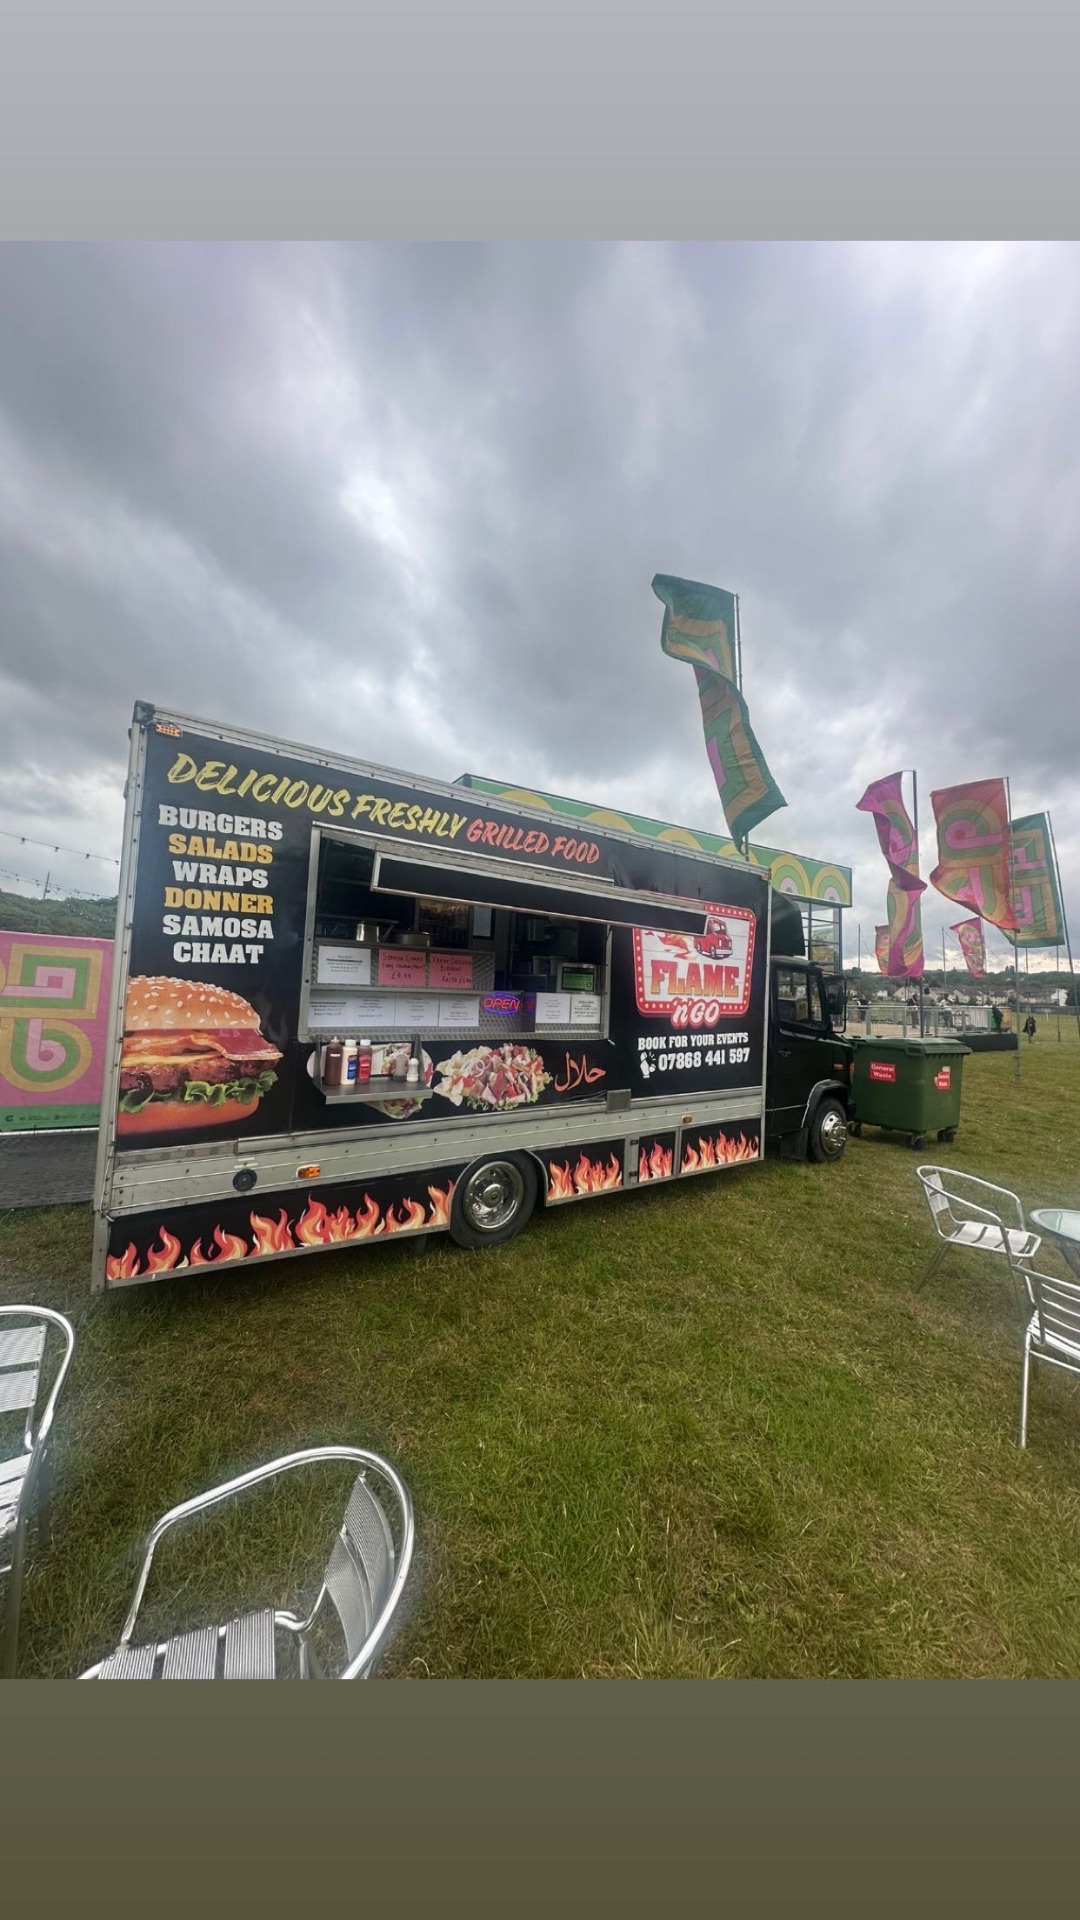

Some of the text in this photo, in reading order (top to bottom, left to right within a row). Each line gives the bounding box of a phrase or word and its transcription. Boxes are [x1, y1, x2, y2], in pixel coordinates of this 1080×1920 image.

[167, 752, 600, 865] DELICIOUS FRESHLY GRILLED FOOD
[158, 804, 283, 841] BURGERS
[168, 833, 273, 864] SALADS
[172, 860, 269, 889] WRAPS
[164, 886, 274, 915] DONNER
[162, 914, 274, 940] SAMOSA
[173, 940, 264, 964] CHAAT
[650, 959, 740, 998] FLAME
[482, 997, 521, 1011] OPEN
[638, 1032, 749, 1051] BOOK FOR YOUR EVENTS
[555, 1050, 607, 1093] حلال
[658, 1047, 751, 1072] 07868 441 597
[871, 1064, 895, 1072] General
[873, 1071, 892, 1079] Waste
